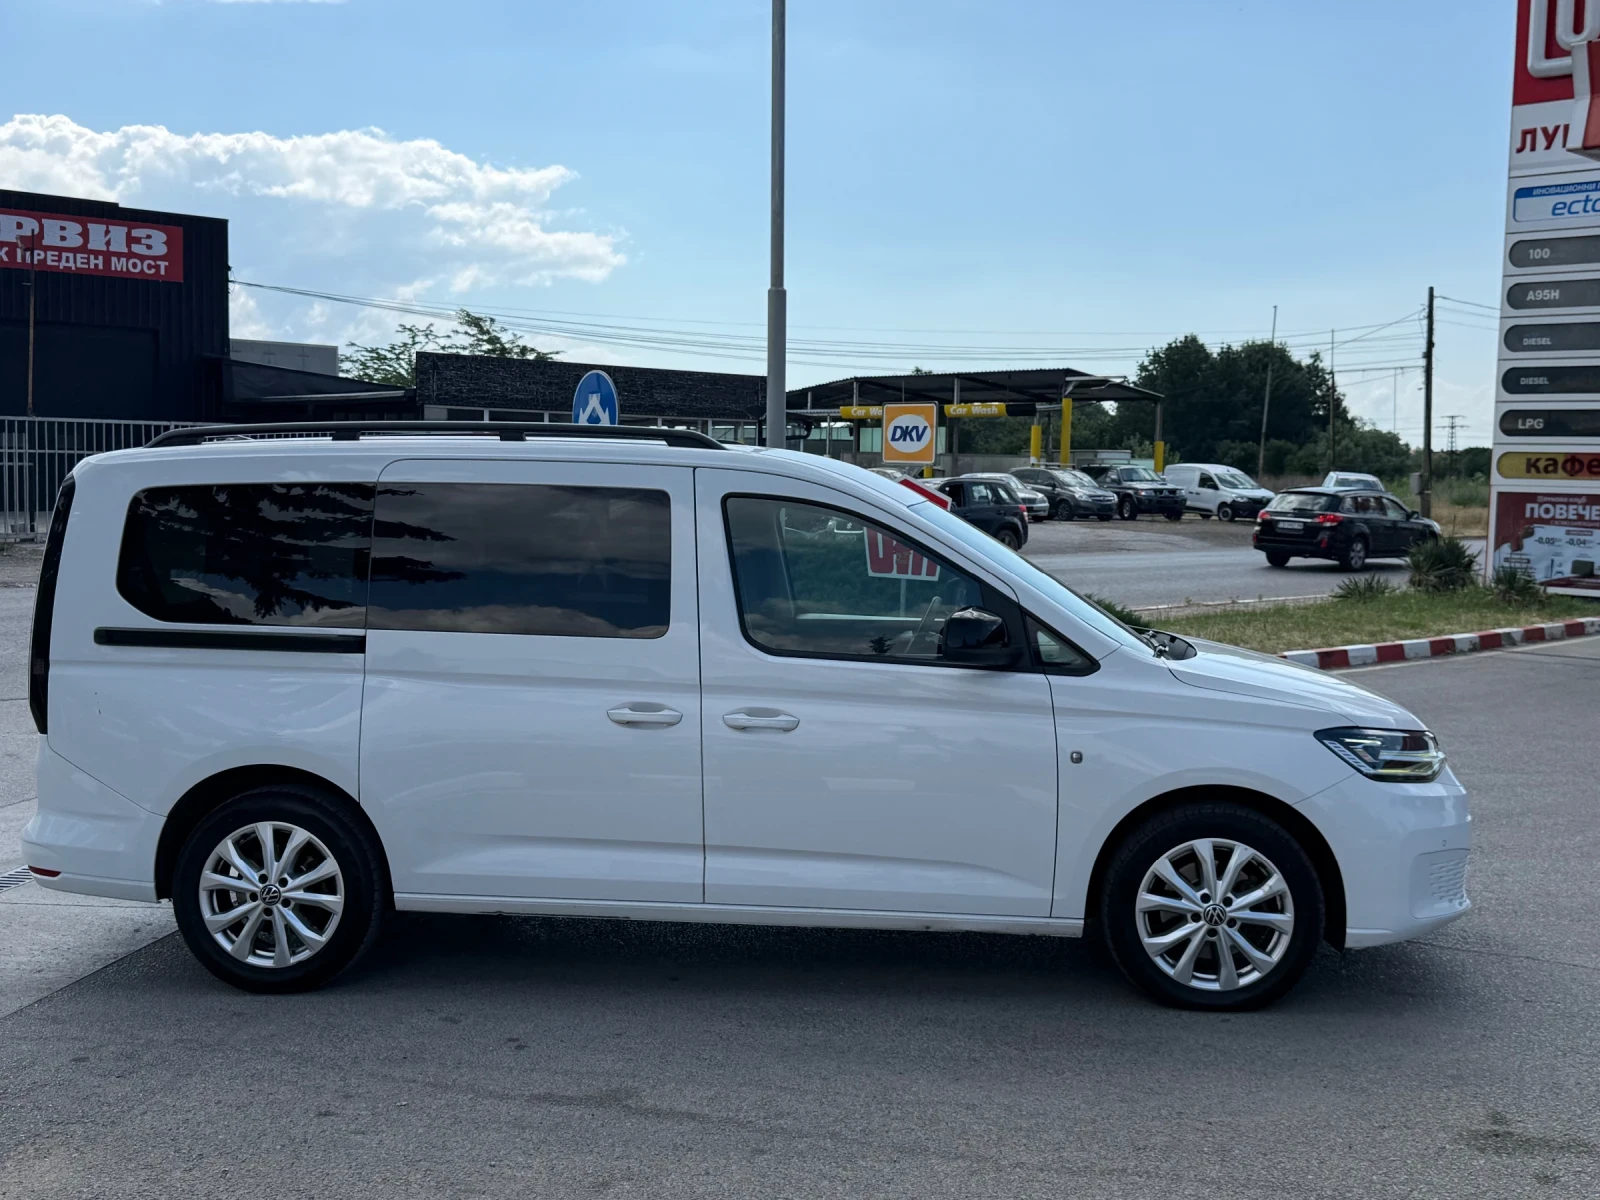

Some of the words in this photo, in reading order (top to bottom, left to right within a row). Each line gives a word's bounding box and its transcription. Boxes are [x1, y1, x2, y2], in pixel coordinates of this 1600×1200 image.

[1528, 248, 1551, 260] 100
[111, 256, 169, 276] МОСТ
[1522, 337, 1552, 346] DIESEL
[1520, 376, 1550, 385] DIESEL
[851, 407, 866, 416] Car
[869, 407, 883, 416] Wa
[951, 406, 967, 415] Car
[971, 405, 999, 415] Wash
[1517, 418, 1545, 429] LPG
[890, 425, 929, 442] DKV
[1525, 503, 1600, 520] ПОВЕЧЕ
